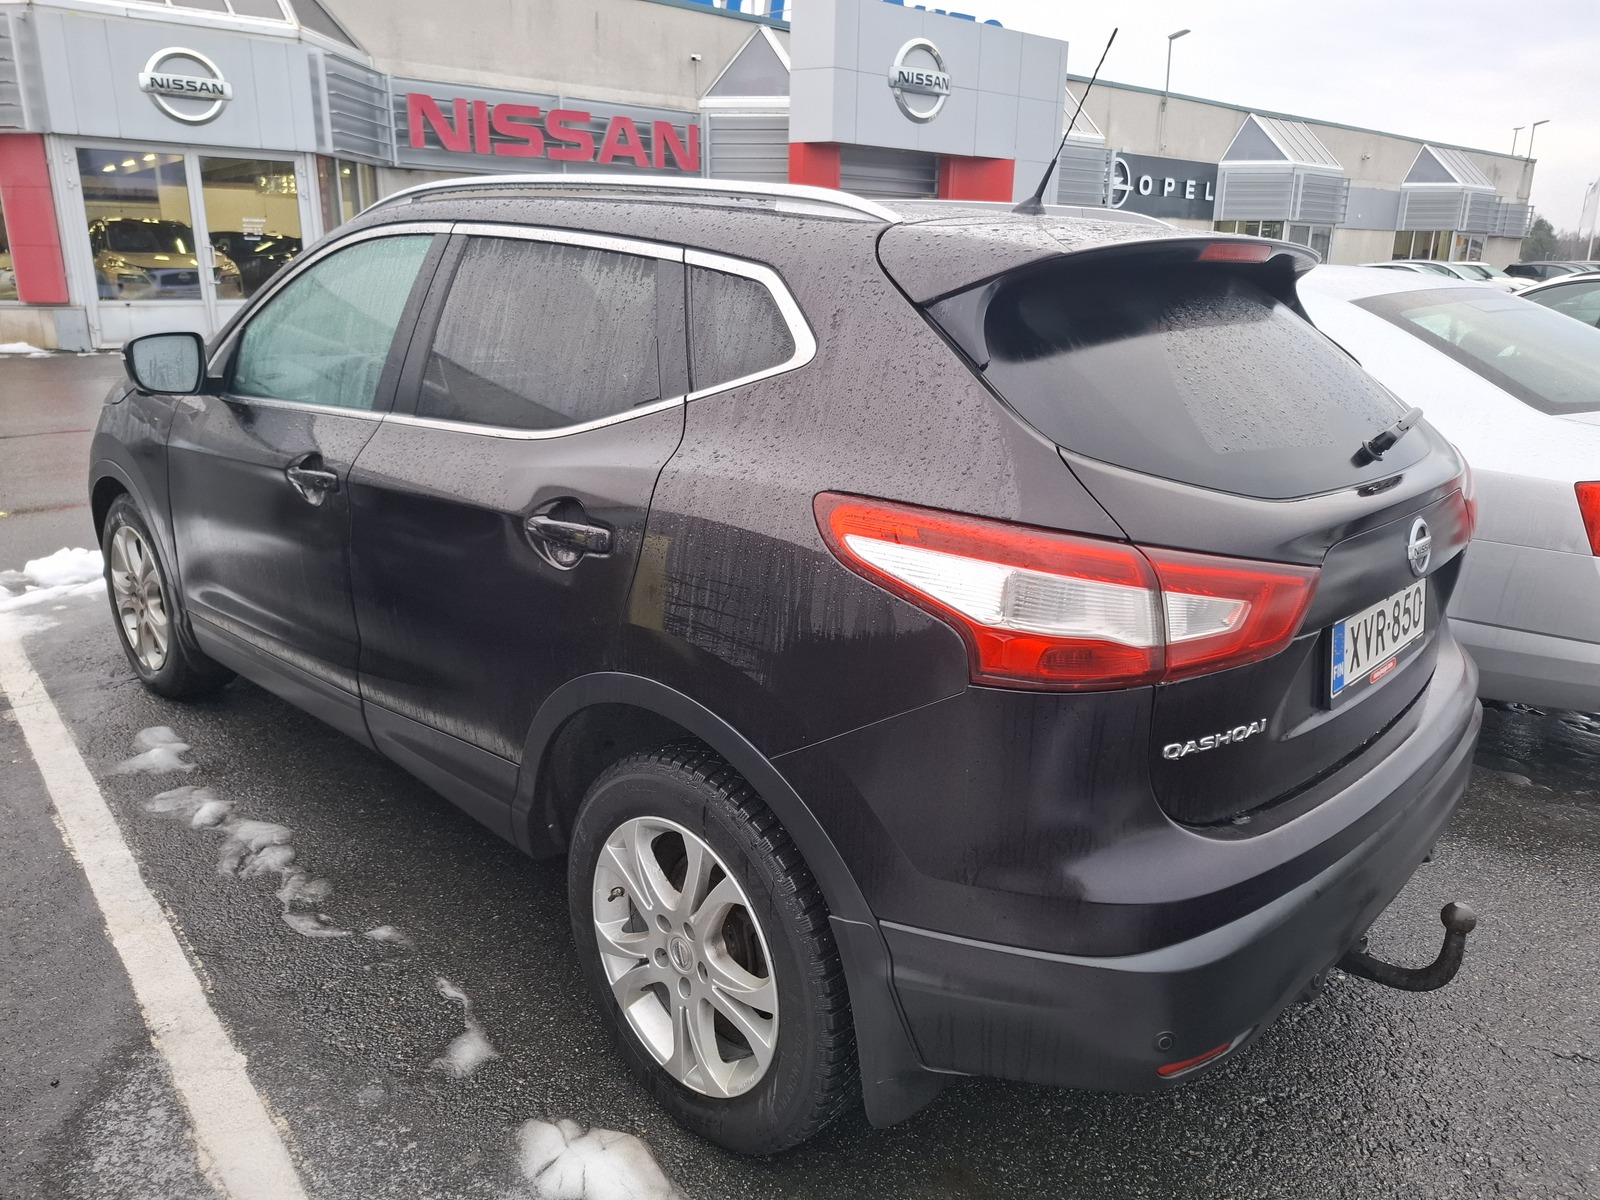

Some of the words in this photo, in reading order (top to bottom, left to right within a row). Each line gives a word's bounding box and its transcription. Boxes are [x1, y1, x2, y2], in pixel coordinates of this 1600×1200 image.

[149, 76, 225, 96] NISSAN
[897, 69, 951, 92] NISSAN
[405, 92, 699, 172] NISSAN
[1139, 174, 1214, 201] OPEL
[1348, 586, 1422, 674] XVR-850
[1333, 660, 1345, 681] FIN
[1162, 717, 1267, 761] QASHQAI
